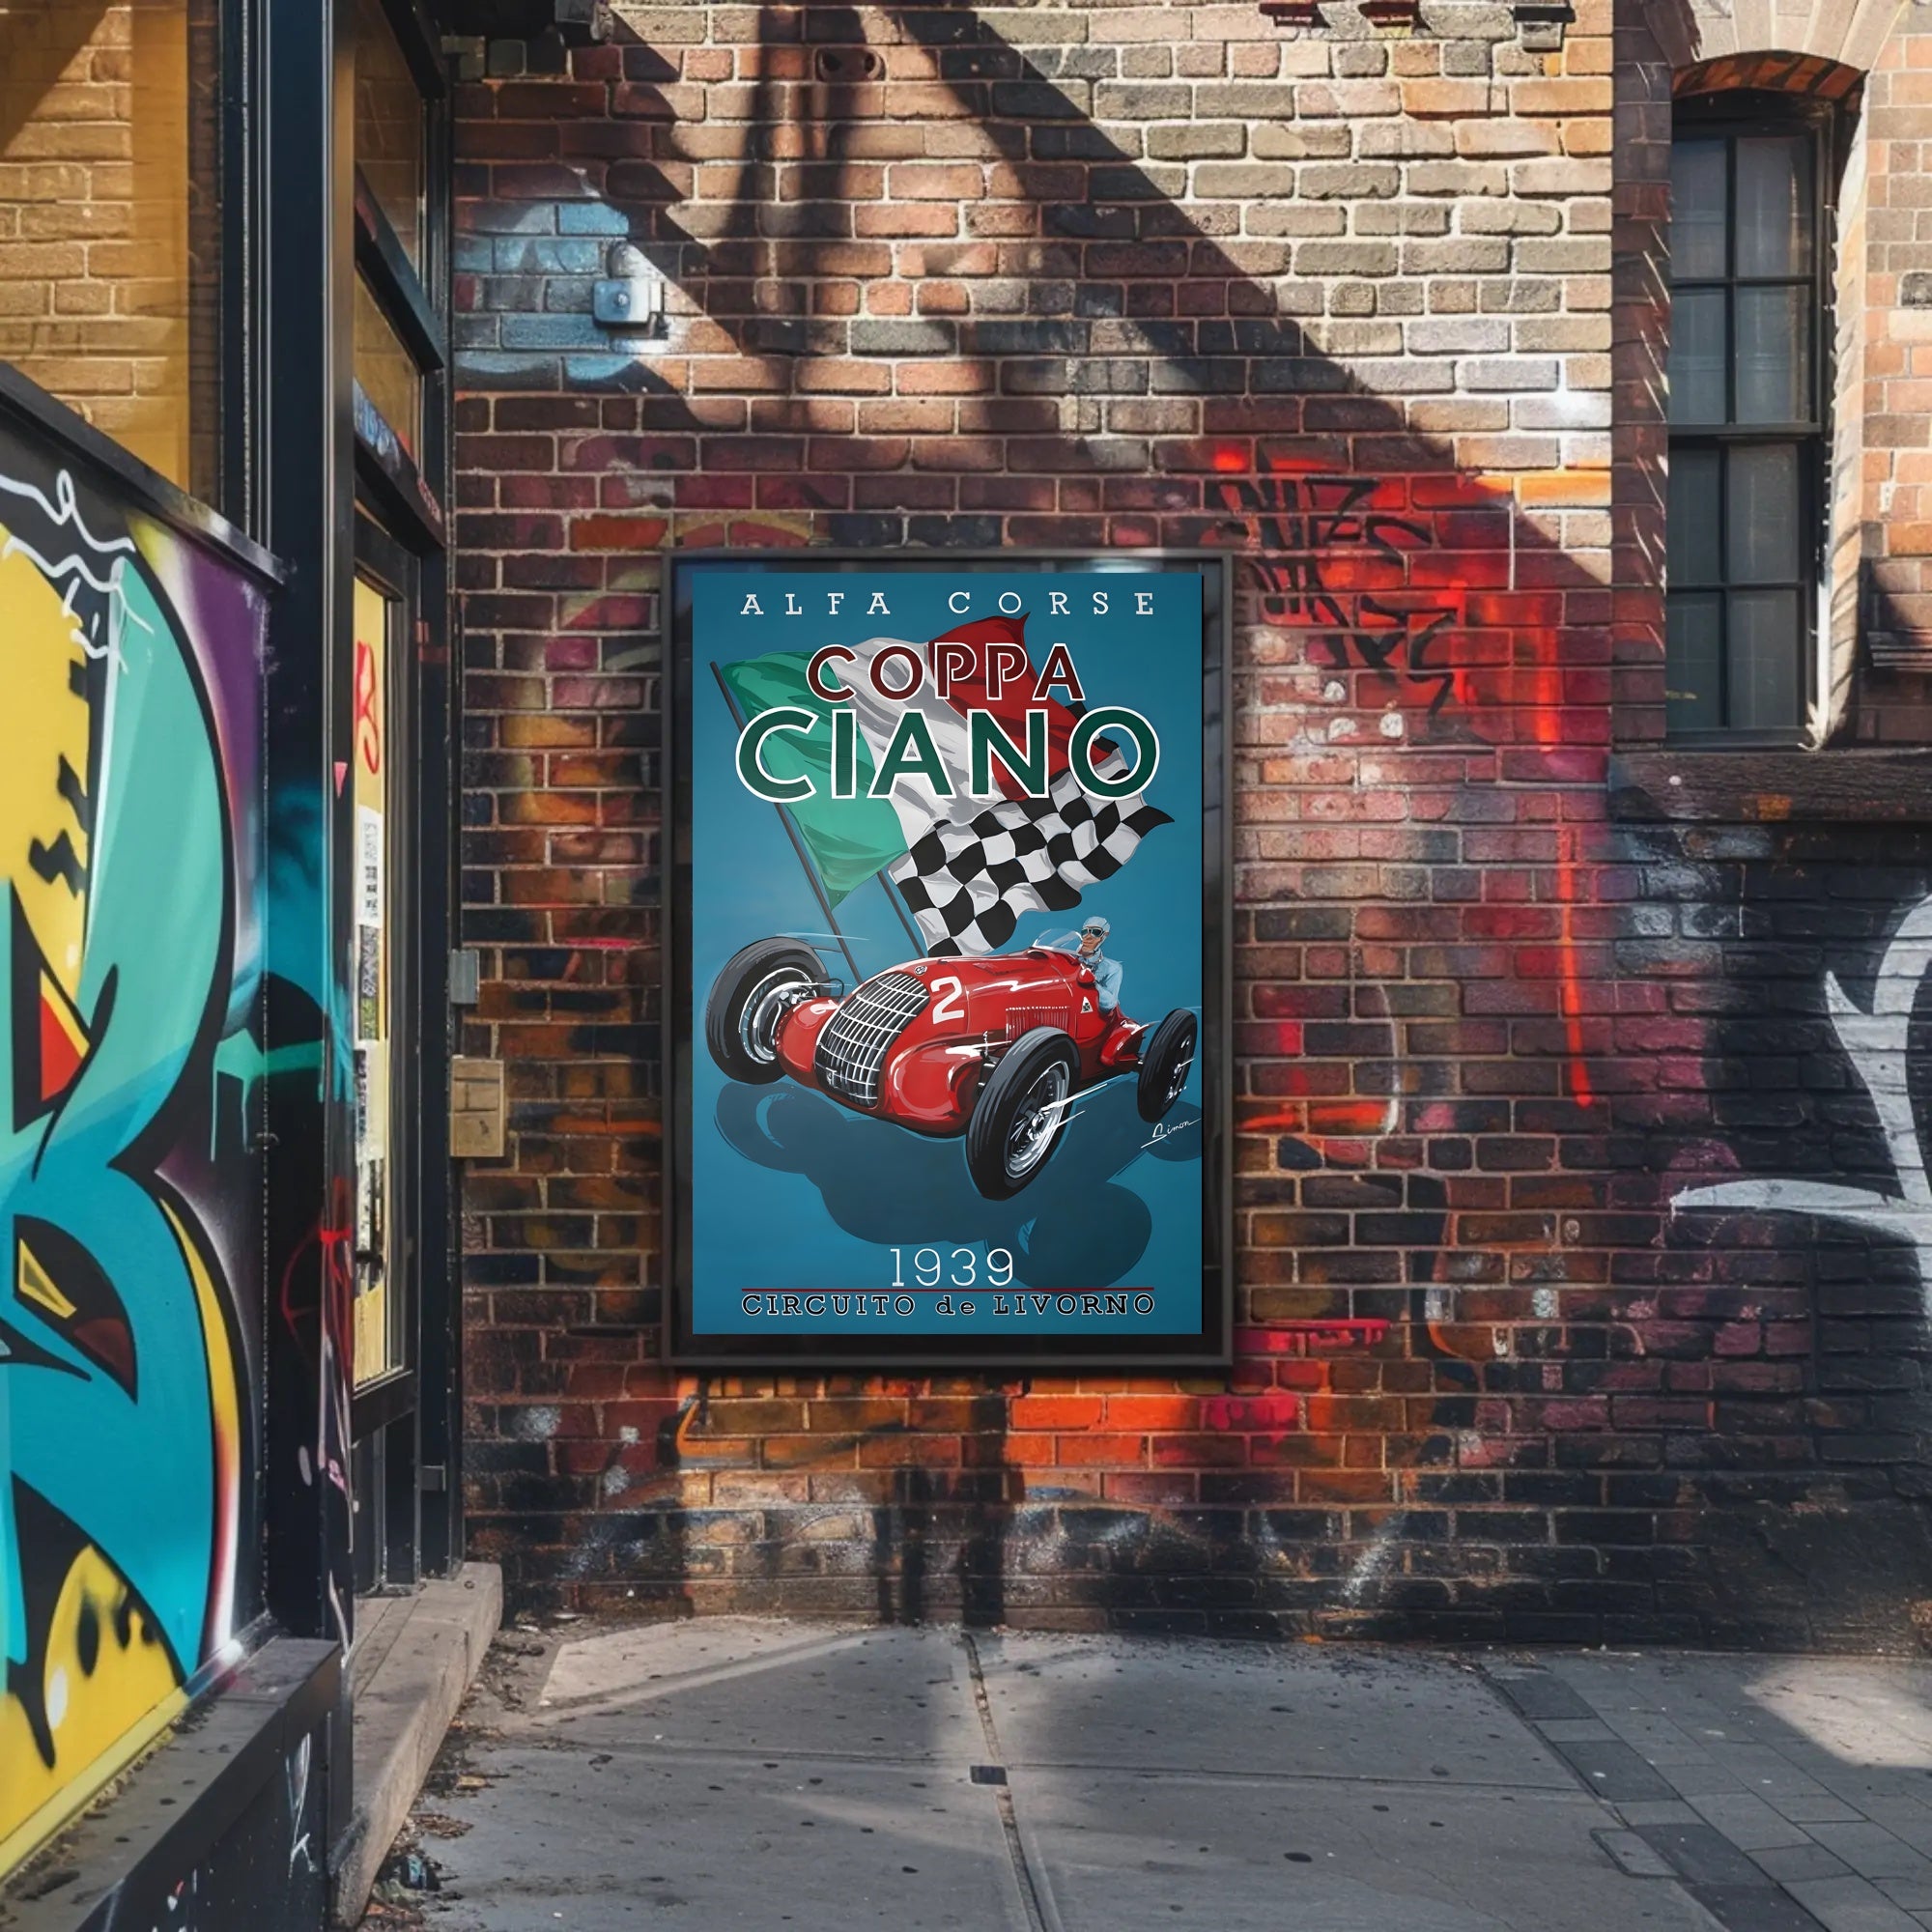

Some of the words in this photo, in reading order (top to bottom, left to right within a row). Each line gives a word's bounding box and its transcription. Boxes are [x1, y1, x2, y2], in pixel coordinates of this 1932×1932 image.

[740, 592, 891, 615] ALFA
[948, 591, 1154, 615] CORSE
[806, 641, 1086, 703] COPPA
[735, 705, 1161, 804] CIANO
[929, 976, 965, 1025] 2
[889, 1247, 1015, 1288] 1939
[741, 1293, 916, 1317] CIRCUITO
[934, 1293, 977, 1317] de
[992, 1293, 1155, 1317] LIVORNO
